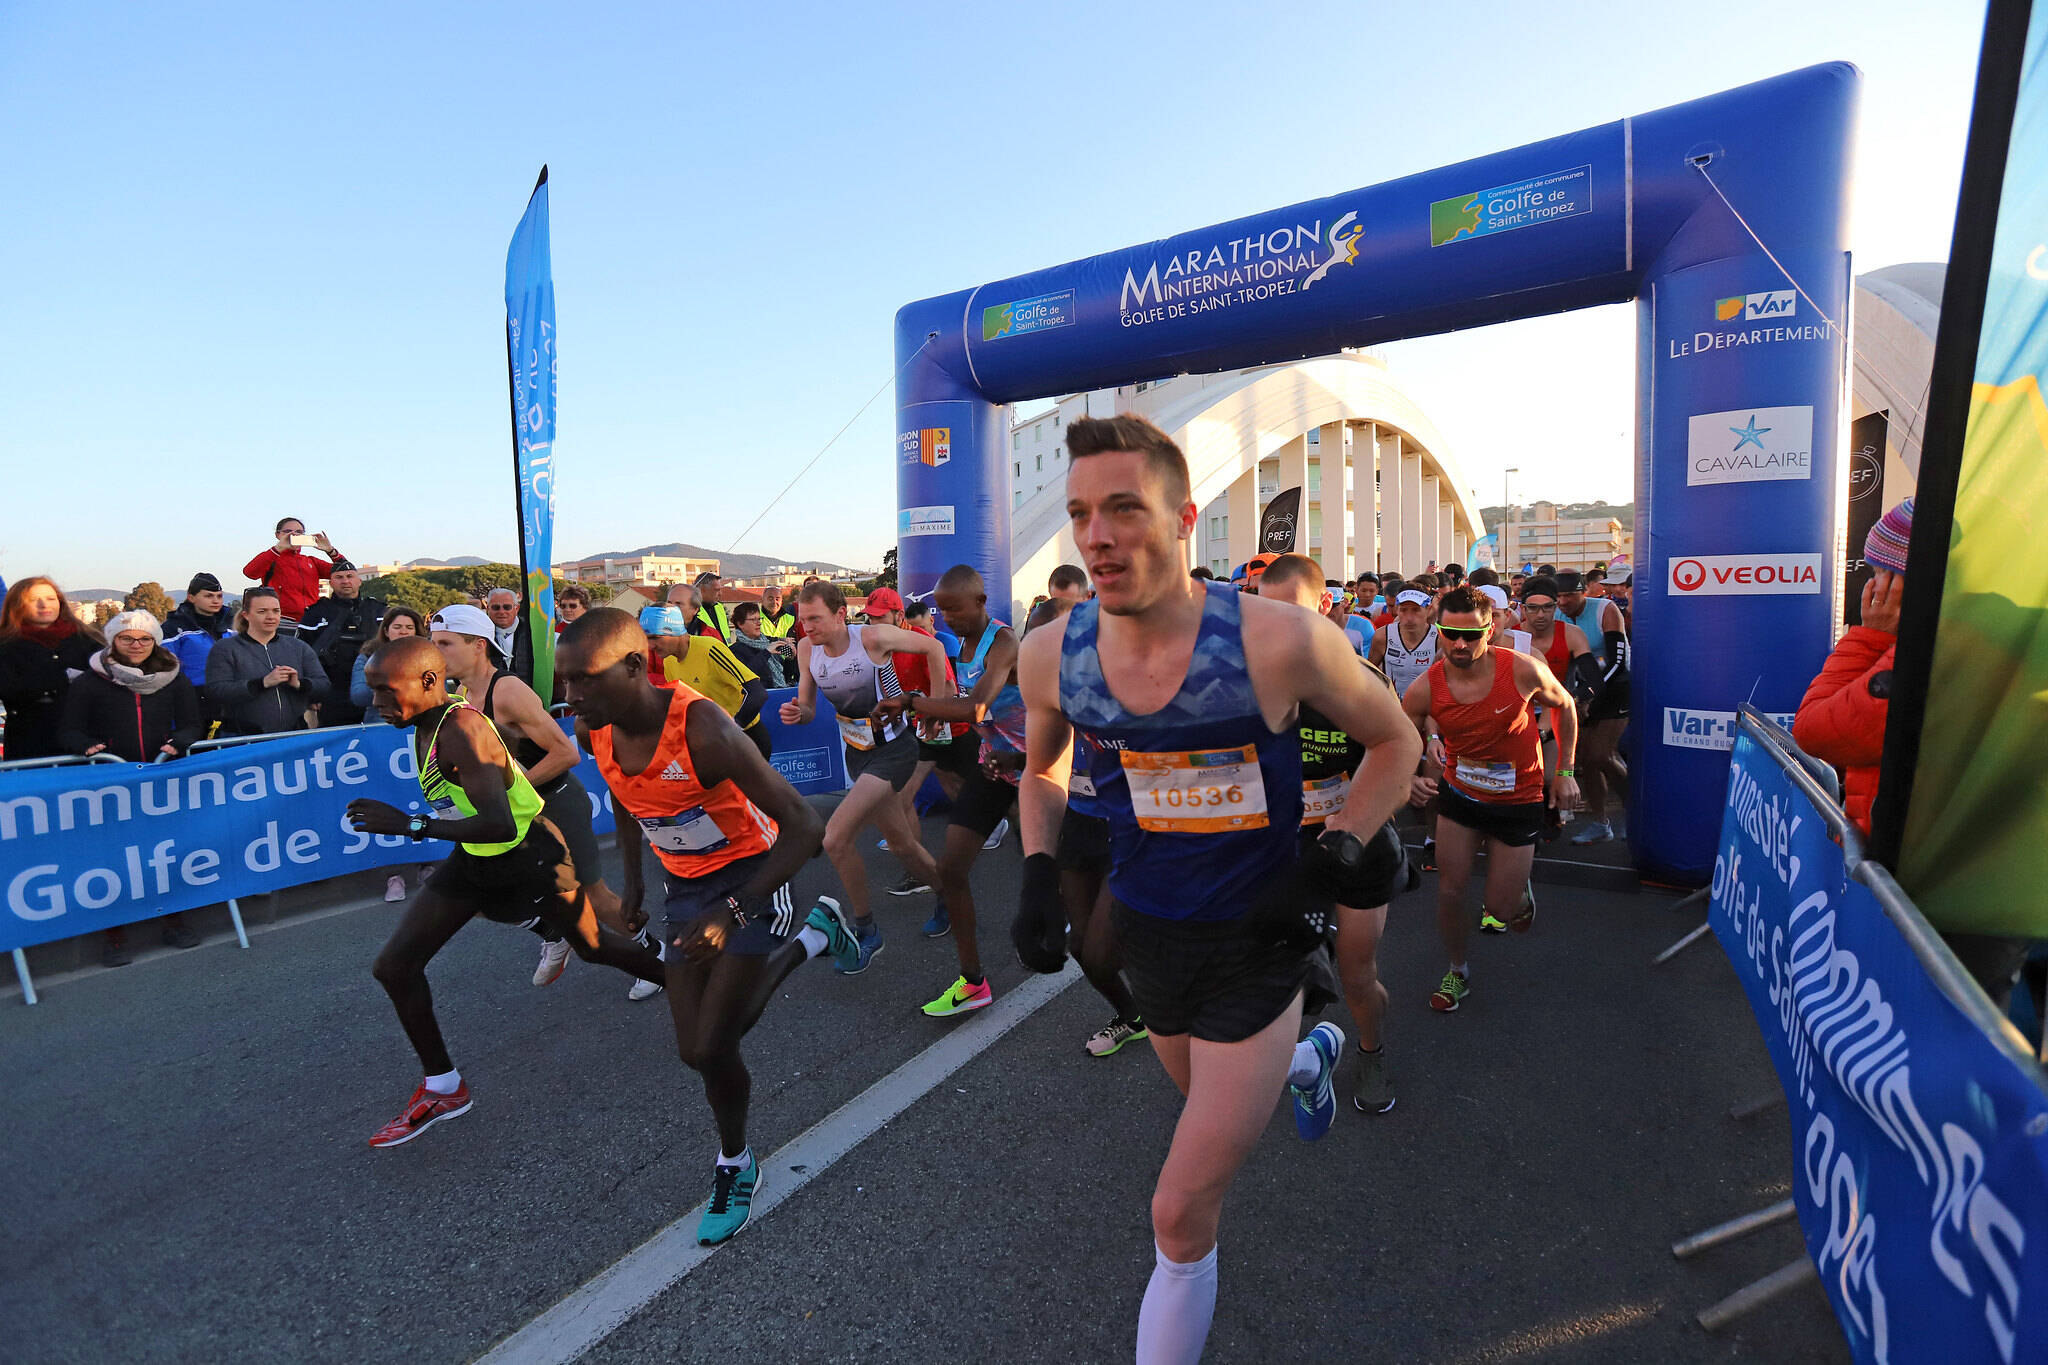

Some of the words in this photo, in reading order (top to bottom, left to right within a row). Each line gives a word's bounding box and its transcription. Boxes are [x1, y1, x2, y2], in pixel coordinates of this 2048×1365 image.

[1487, 183, 1534, 198] Communauté
[1544, 171, 1585, 185] communes
[1488, 191, 1544, 215] Golfe
[1548, 190, 1565, 202] de
[1488, 202, 1575, 229] Saint-Tropez
[1120, 219, 1320, 310] MARATHON
[1164, 250, 1320, 301] INTERNATIONAL
[1016, 305, 1047, 321] Golfe
[1049, 306, 1060, 314] de
[1120, 306, 1165, 327] GOLFE
[1168, 302, 1187, 319] DE
[1190, 279, 1297, 314] SAINT-TROPEZ
[1015, 315, 1065, 331] Saint-Tropez
[903, 441, 919, 452] SUD
[1695, 452, 1809, 473] CAVALAIRE
[1267, 530, 1291, 541] PREF
[1712, 565, 1817, 585] VEOLIA
[806, 761, 817, 769] de
[1149, 785, 1244, 808] 10536
[672, 836, 687, 846] 2
[7, 838, 220, 921] Golfe
[244, 820, 321, 873] de
